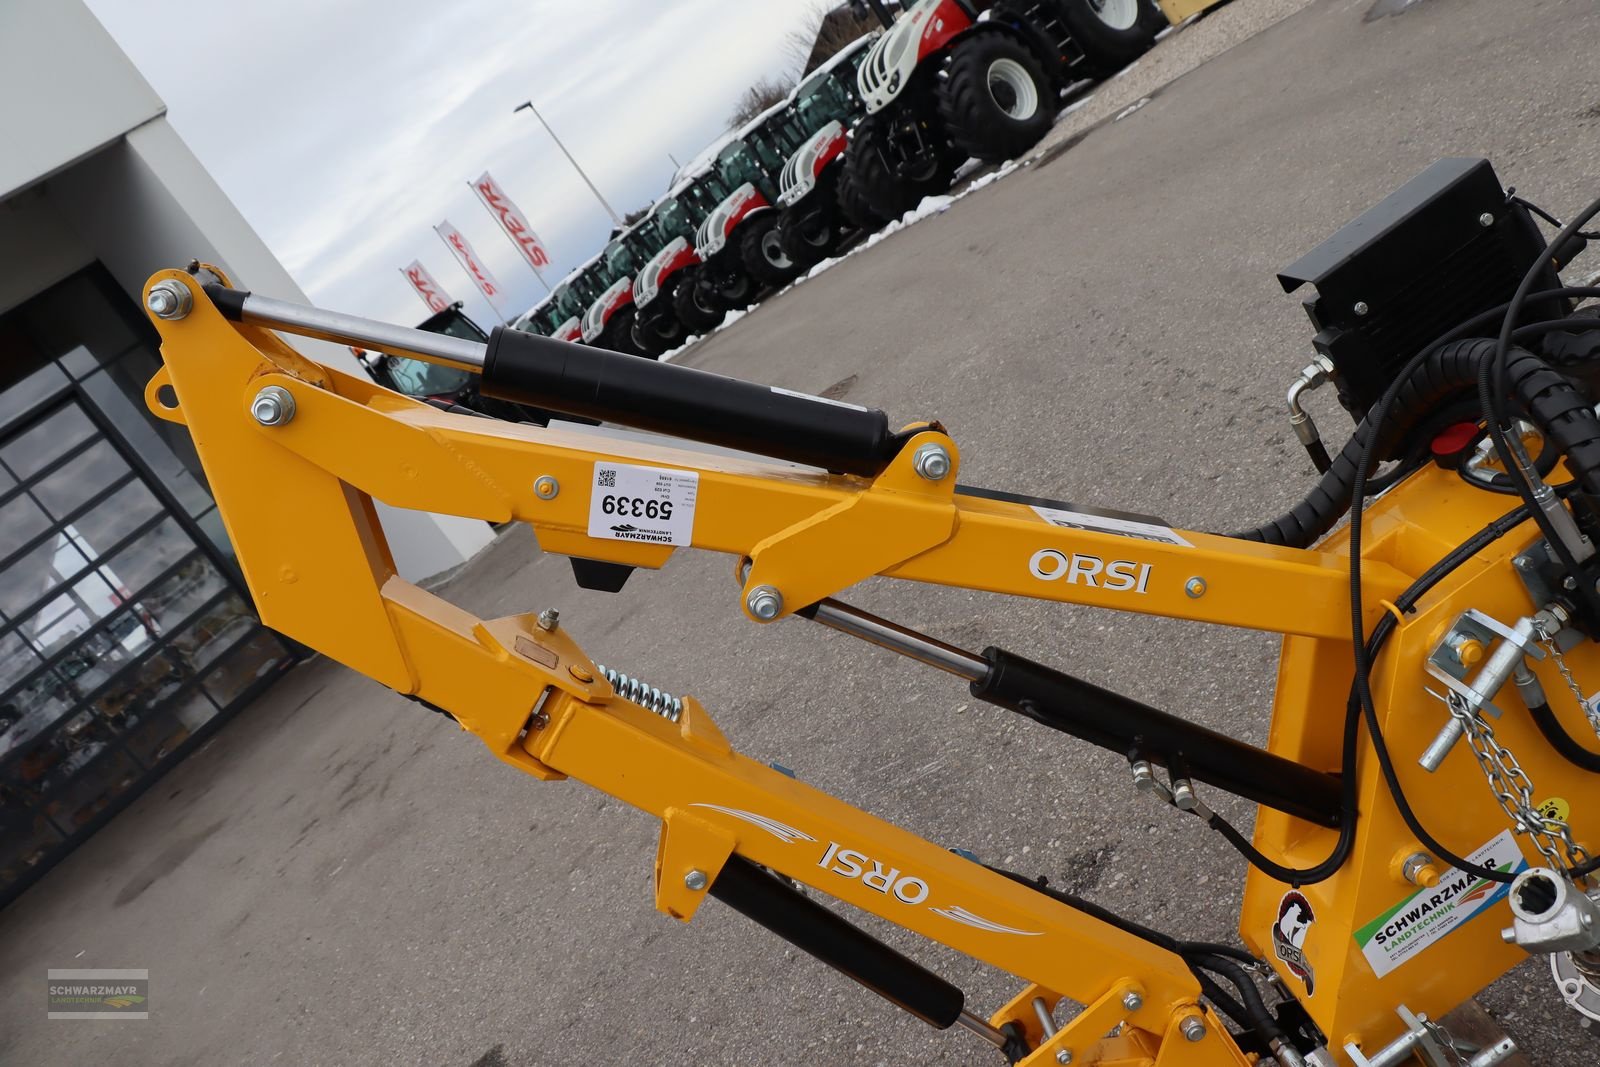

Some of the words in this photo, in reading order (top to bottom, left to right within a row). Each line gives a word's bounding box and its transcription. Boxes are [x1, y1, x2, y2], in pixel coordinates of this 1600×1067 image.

[479, 182, 549, 266] STEYR
[408, 268, 448, 312] EYR
[602, 495, 673, 520] 59339
[615, 532, 672, 542] SCHWARZMAYR
[1029, 548, 1154, 594] ORSI
[816, 841, 929, 905] ORSI
[1383, 901, 1456, 952] LANDTECHNIK
